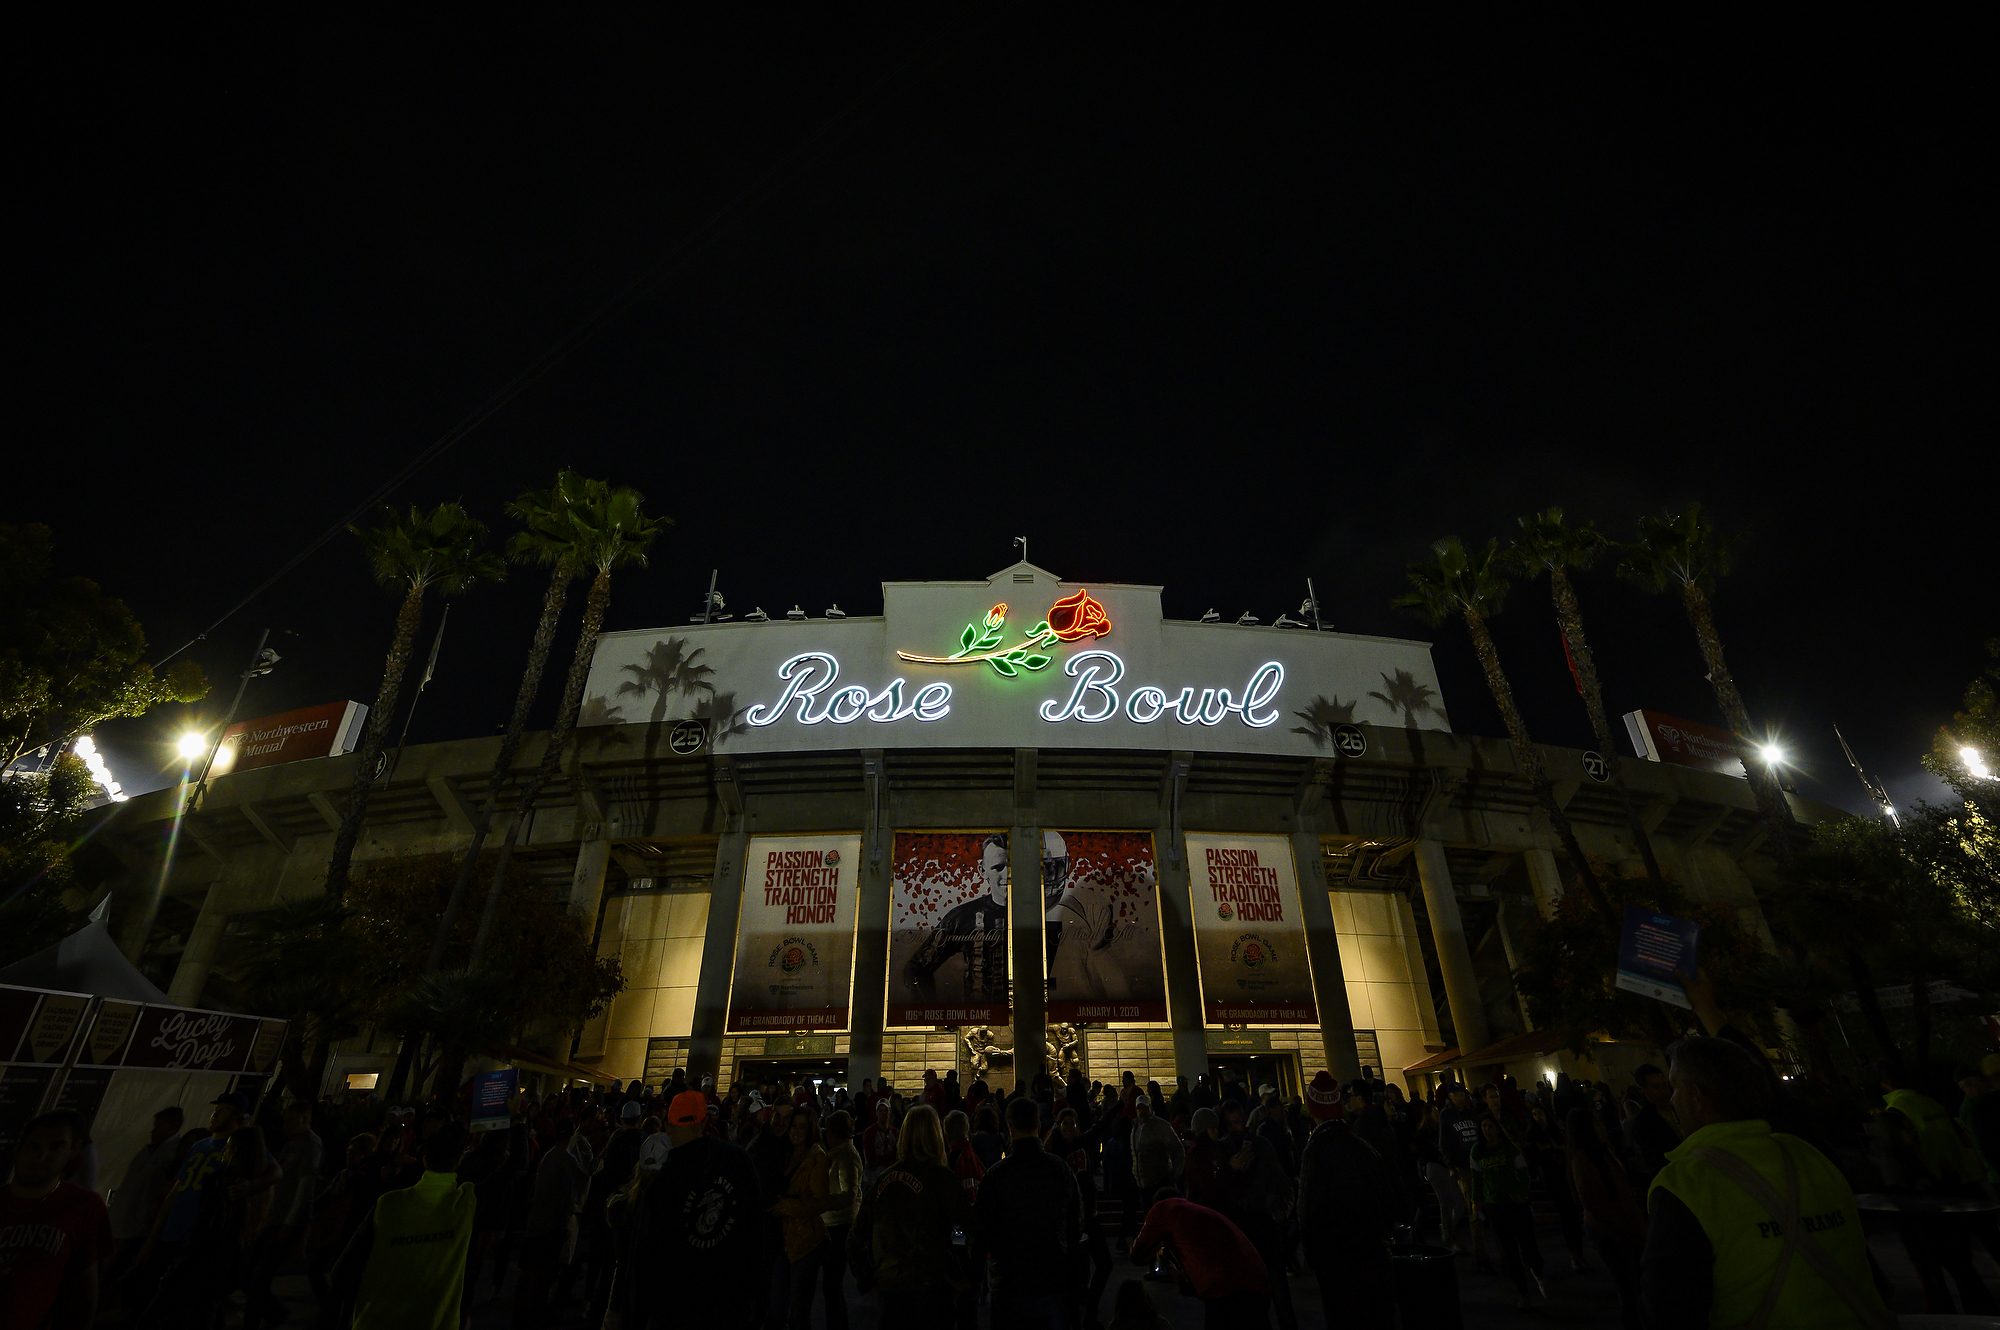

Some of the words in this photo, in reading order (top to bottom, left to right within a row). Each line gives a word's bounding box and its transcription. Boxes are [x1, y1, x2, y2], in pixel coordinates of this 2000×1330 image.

[747, 651, 953, 728] Rose
[1041, 650, 1285, 729] Bowl
[249, 719, 329, 742] Northwestern
[673, 727, 701, 747] 25
[244, 738, 287, 757] Mutual
[1338, 731, 1363, 751] 26
[1584, 757, 1604, 776] 27
[767, 851, 823, 869] PASSION
[1206, 848, 1258, 867] PASSION
[765, 868, 838, 887] STRENGTH
[1208, 866, 1278, 885] STRENGTH
[764, 886, 837, 906] TRADITION
[1210, 884, 1281, 903] TRADITION
[786, 905, 836, 924] HONOR
[1237, 902, 1284, 922] HONOR
[769, 943, 783, 967] ROSE
[784, 937, 805, 947] BOWL
[807, 941, 819, 967] GAME
[1231, 939, 1241, 962] ROSE
[1240, 934, 1261, 943] BOWL
[1262, 940, 1278, 962] GAME
[739, 1017, 751, 1026] THE
[753, 1016, 797, 1025] GRANDDADDY
[797, 1016, 805, 1025] OF
[806, 1015, 823, 1024] THEM
[824, 1015, 837, 1024] ALL
[924, 1009, 945, 1020] ROSE
[946, 1009, 969, 1020] BOWL
[970, 1008, 991, 1020] GAME
[1077, 1006, 1111, 1017] JANUARY
[1120, 1006, 1139, 1017] 2020
[1216, 1009, 1228, 1019] THE
[1229, 1009, 1269, 1019] GRANDDADDY
[1270, 1009, 1278, 1018] OF
[1279, 1009, 1295, 1018] THEM
[1296, 1009, 1308, 1019] ALL
[151, 1012, 235, 1048] Lucky
[166, 1039, 236, 1070] Dogs
[1758, 1210, 1846, 1238] PRRAMS
